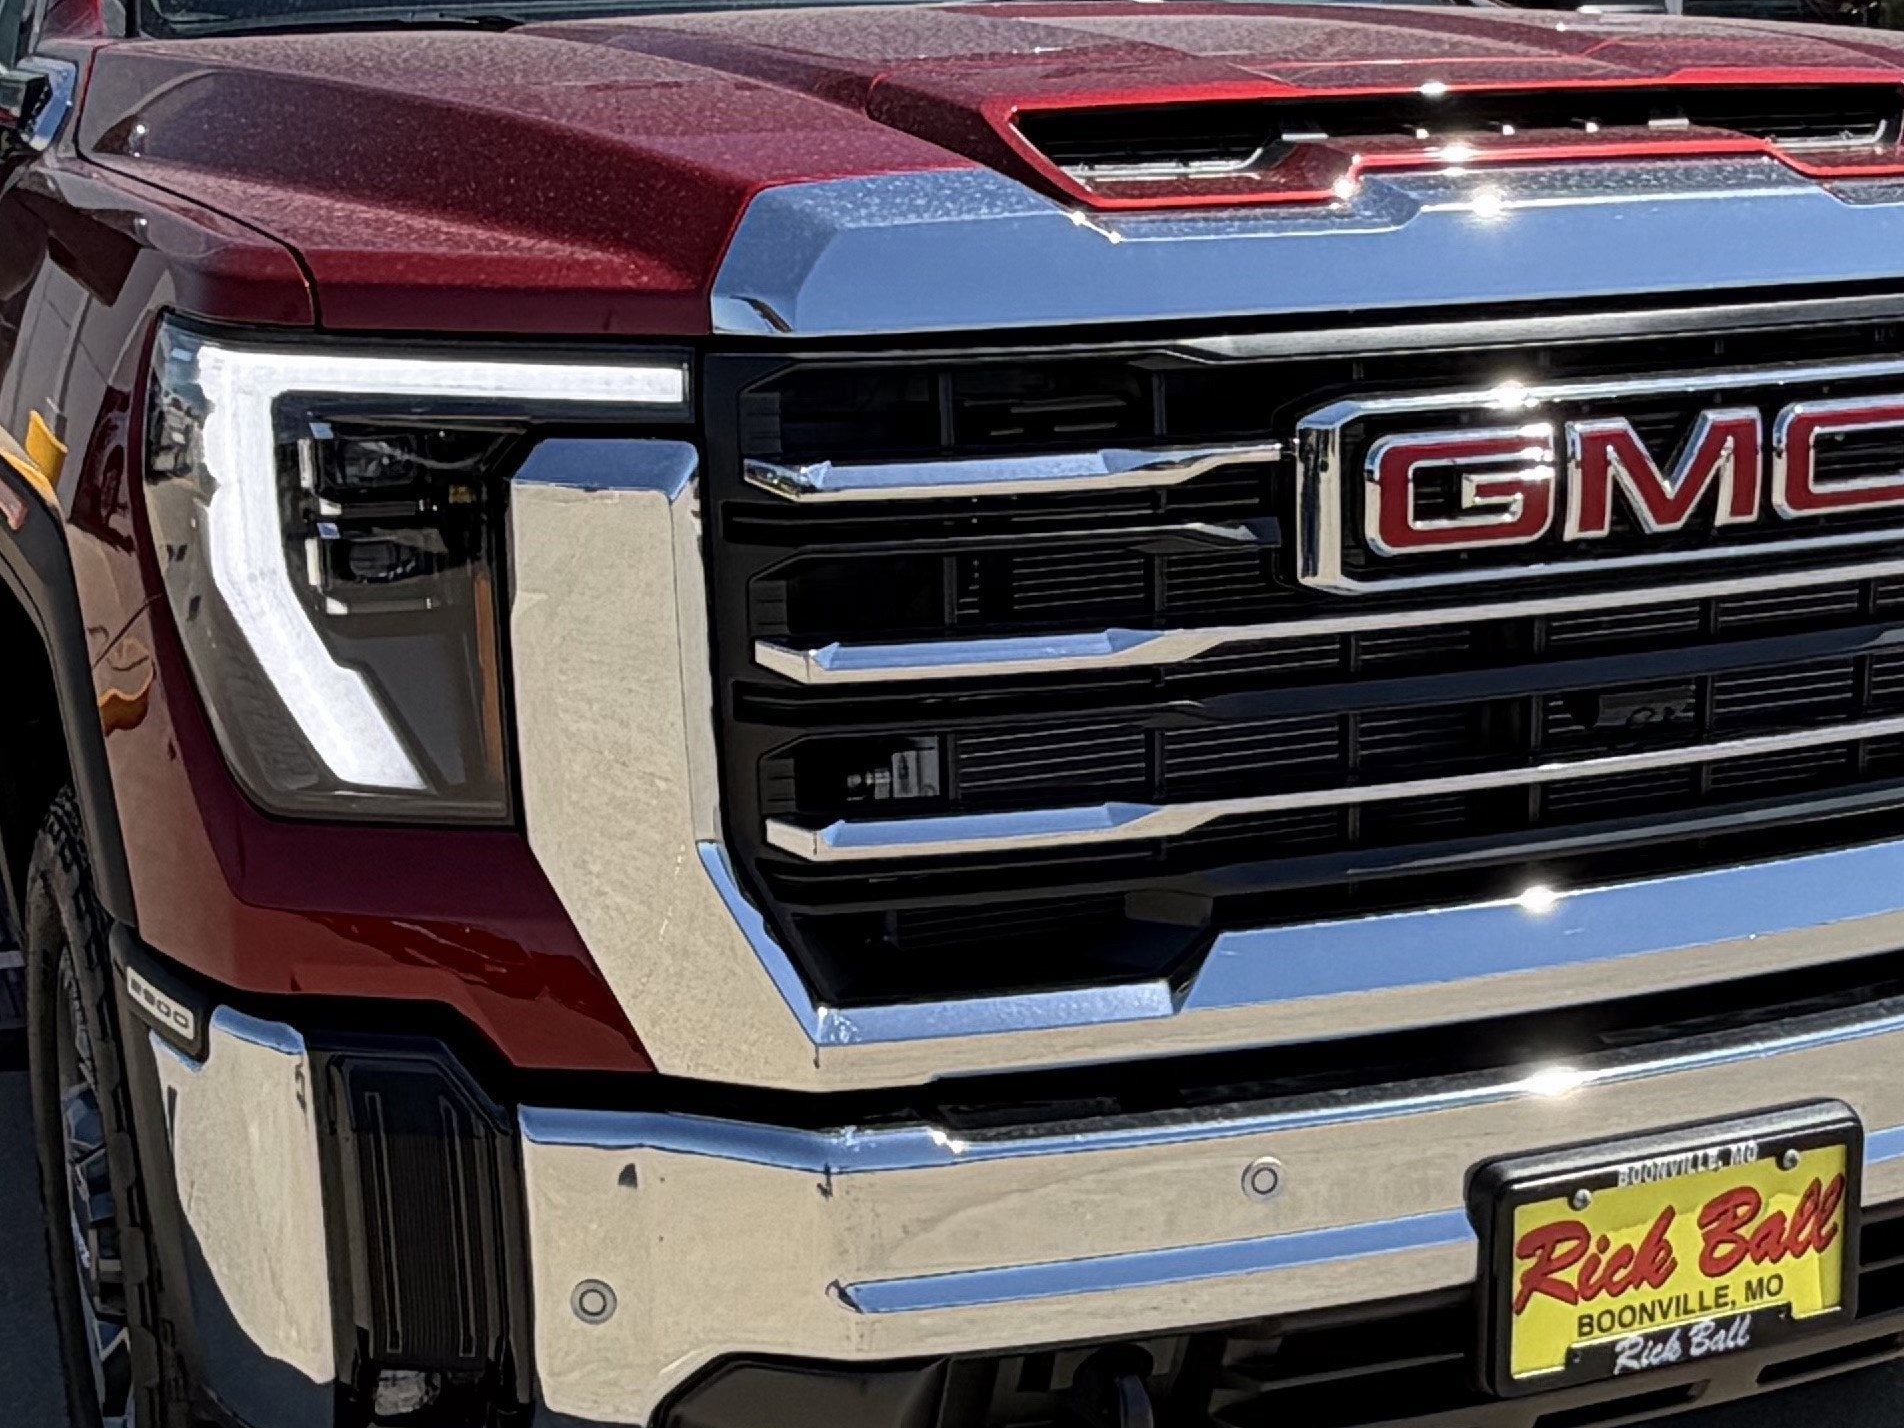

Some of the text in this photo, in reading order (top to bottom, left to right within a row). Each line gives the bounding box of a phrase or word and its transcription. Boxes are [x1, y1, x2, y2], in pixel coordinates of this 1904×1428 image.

[1513, 1172, 1846, 1316] Rick Ball
[1577, 1272, 1784, 1338] BOONVILLE, MO
[1613, 1314, 1751, 1375] Rick Ball
